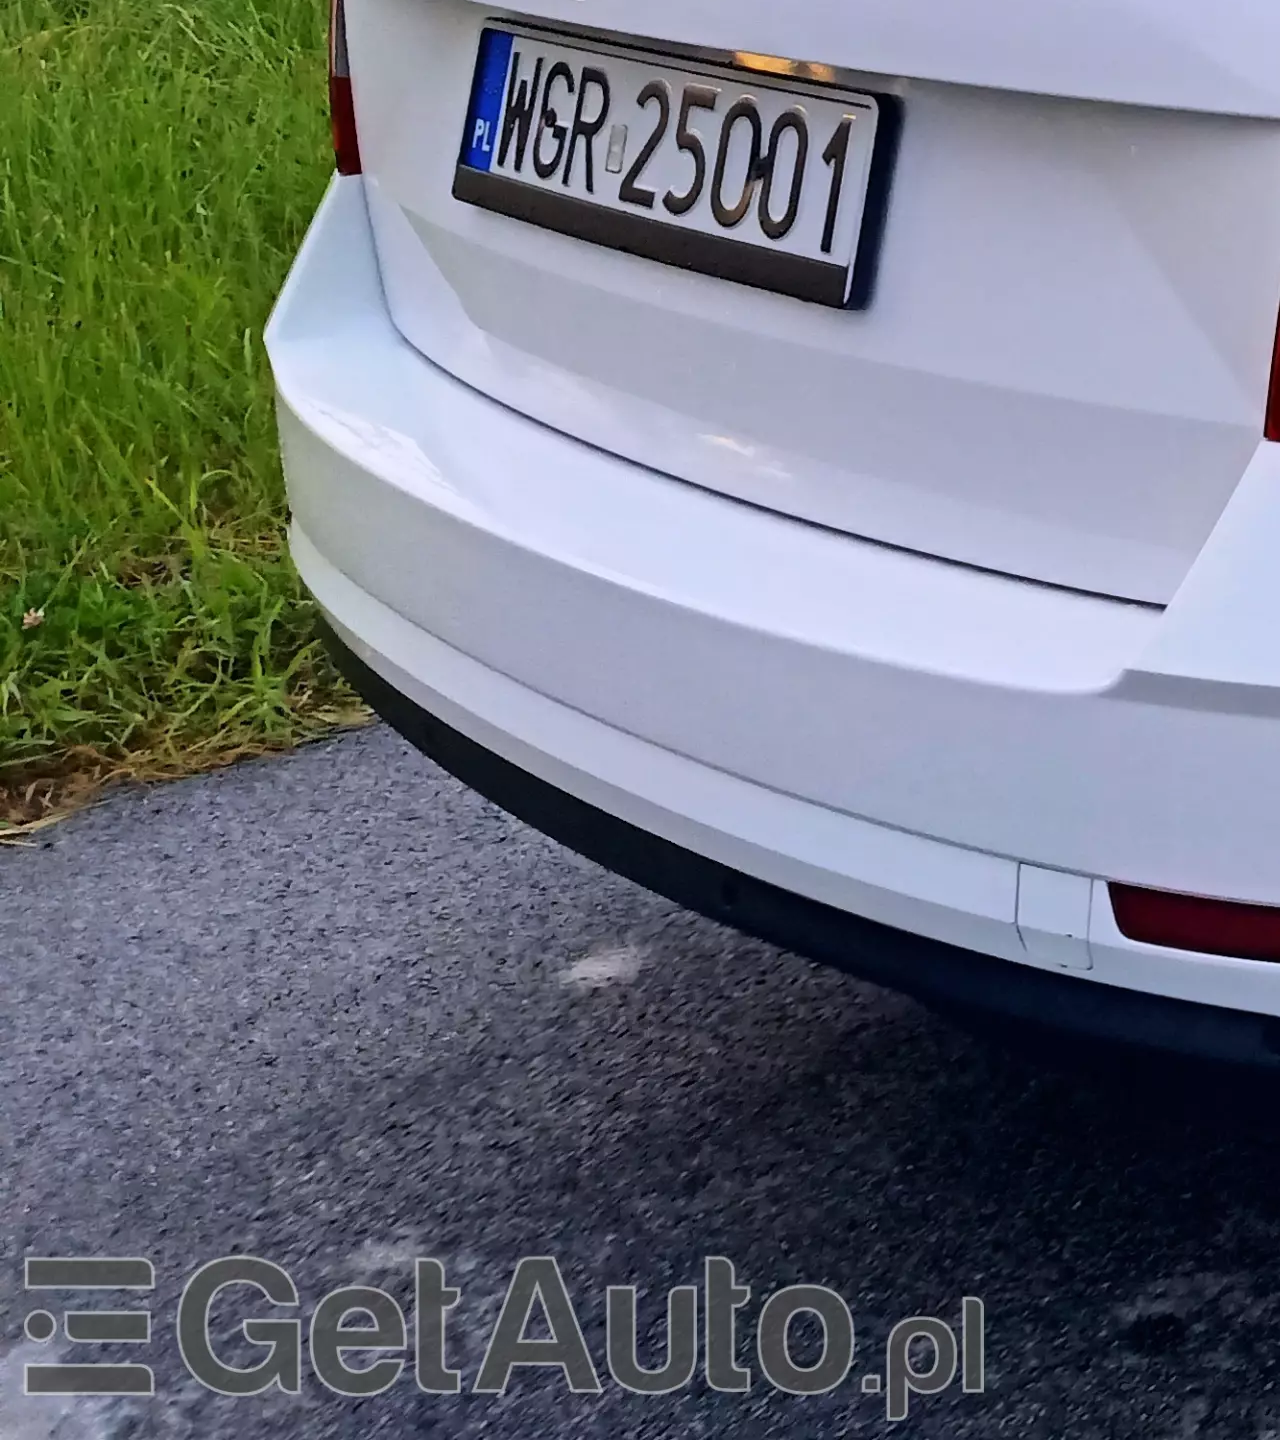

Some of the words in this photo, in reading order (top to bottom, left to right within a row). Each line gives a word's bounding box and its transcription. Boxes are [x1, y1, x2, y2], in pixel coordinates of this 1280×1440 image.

[472, 118, 492, 154] PL
[496, 51, 611, 194] WGR
[618, 80, 857, 254] 25001
